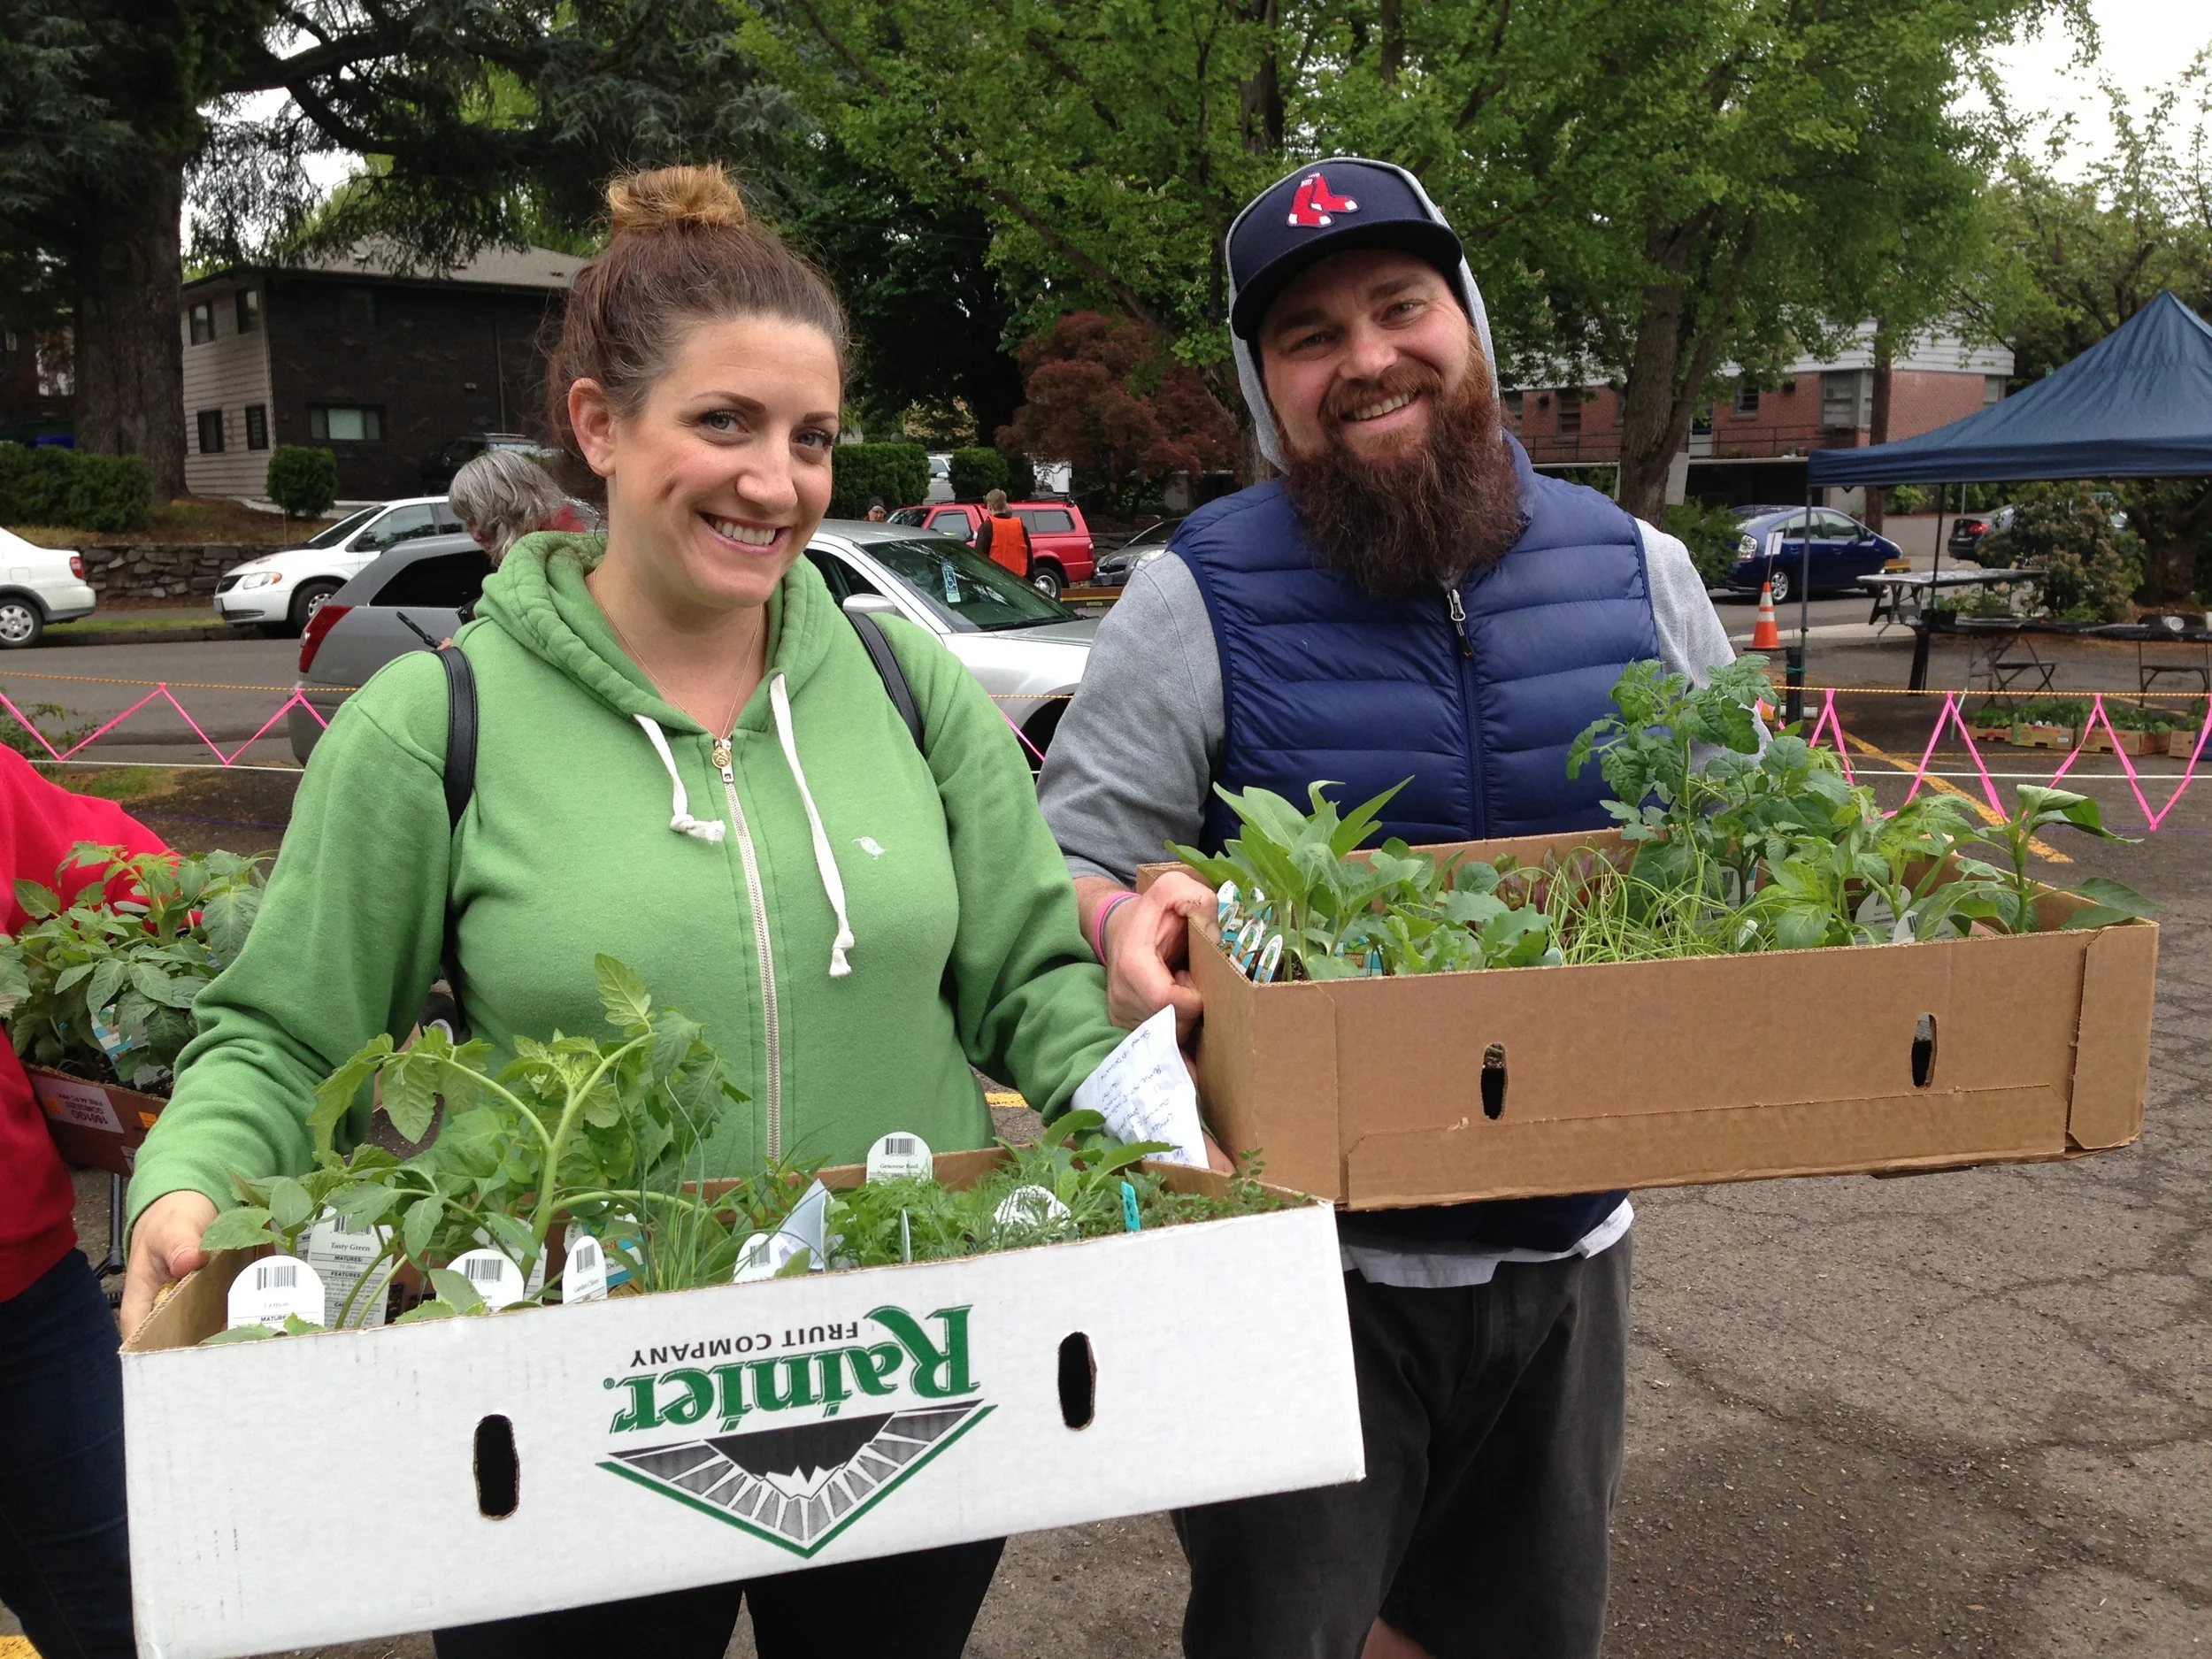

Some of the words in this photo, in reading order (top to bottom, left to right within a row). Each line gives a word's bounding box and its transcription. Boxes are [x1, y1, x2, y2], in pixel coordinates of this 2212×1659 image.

[331, 1242, 349, 1251] Tasty
[349, 1243, 371, 1252] Green
[781, 1321, 859, 1348] FRUIT
[629, 1333, 772, 1368] COMPANY
[609, 1304, 980, 1434] Rainier
